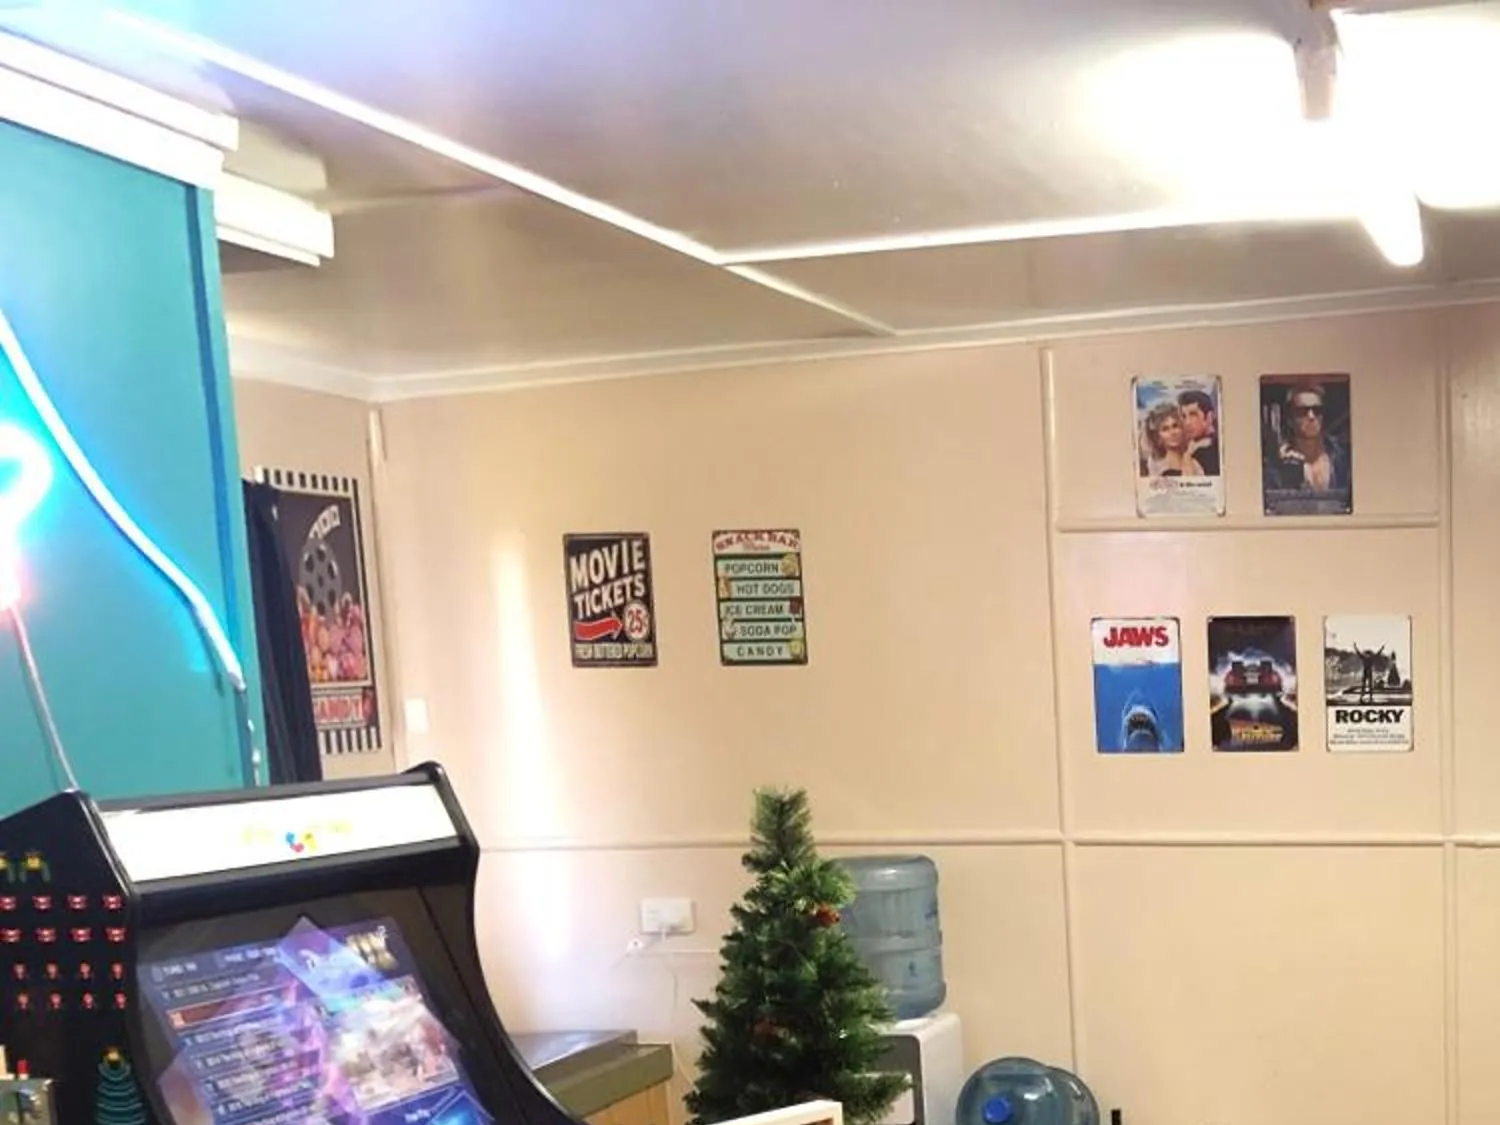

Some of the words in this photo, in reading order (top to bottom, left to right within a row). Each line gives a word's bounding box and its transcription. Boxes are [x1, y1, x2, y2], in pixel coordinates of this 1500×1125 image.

[569, 539, 646, 593] MOVIE
[724, 562, 779, 574] POPCORN
[573, 572, 646, 619] TICKETS
[736, 583, 759, 595] HOT
[762, 582, 795, 595] DOGS
[725, 604, 741, 616] ICE
[745, 603, 784, 615] CREAM
[739, 623, 770, 637] SODA
[773, 623, 798, 636] POP
[1103, 626, 1169, 649] JAWS
[737, 643, 784, 657] CANDY
[1335, 709, 1404, 724] ROCKY
